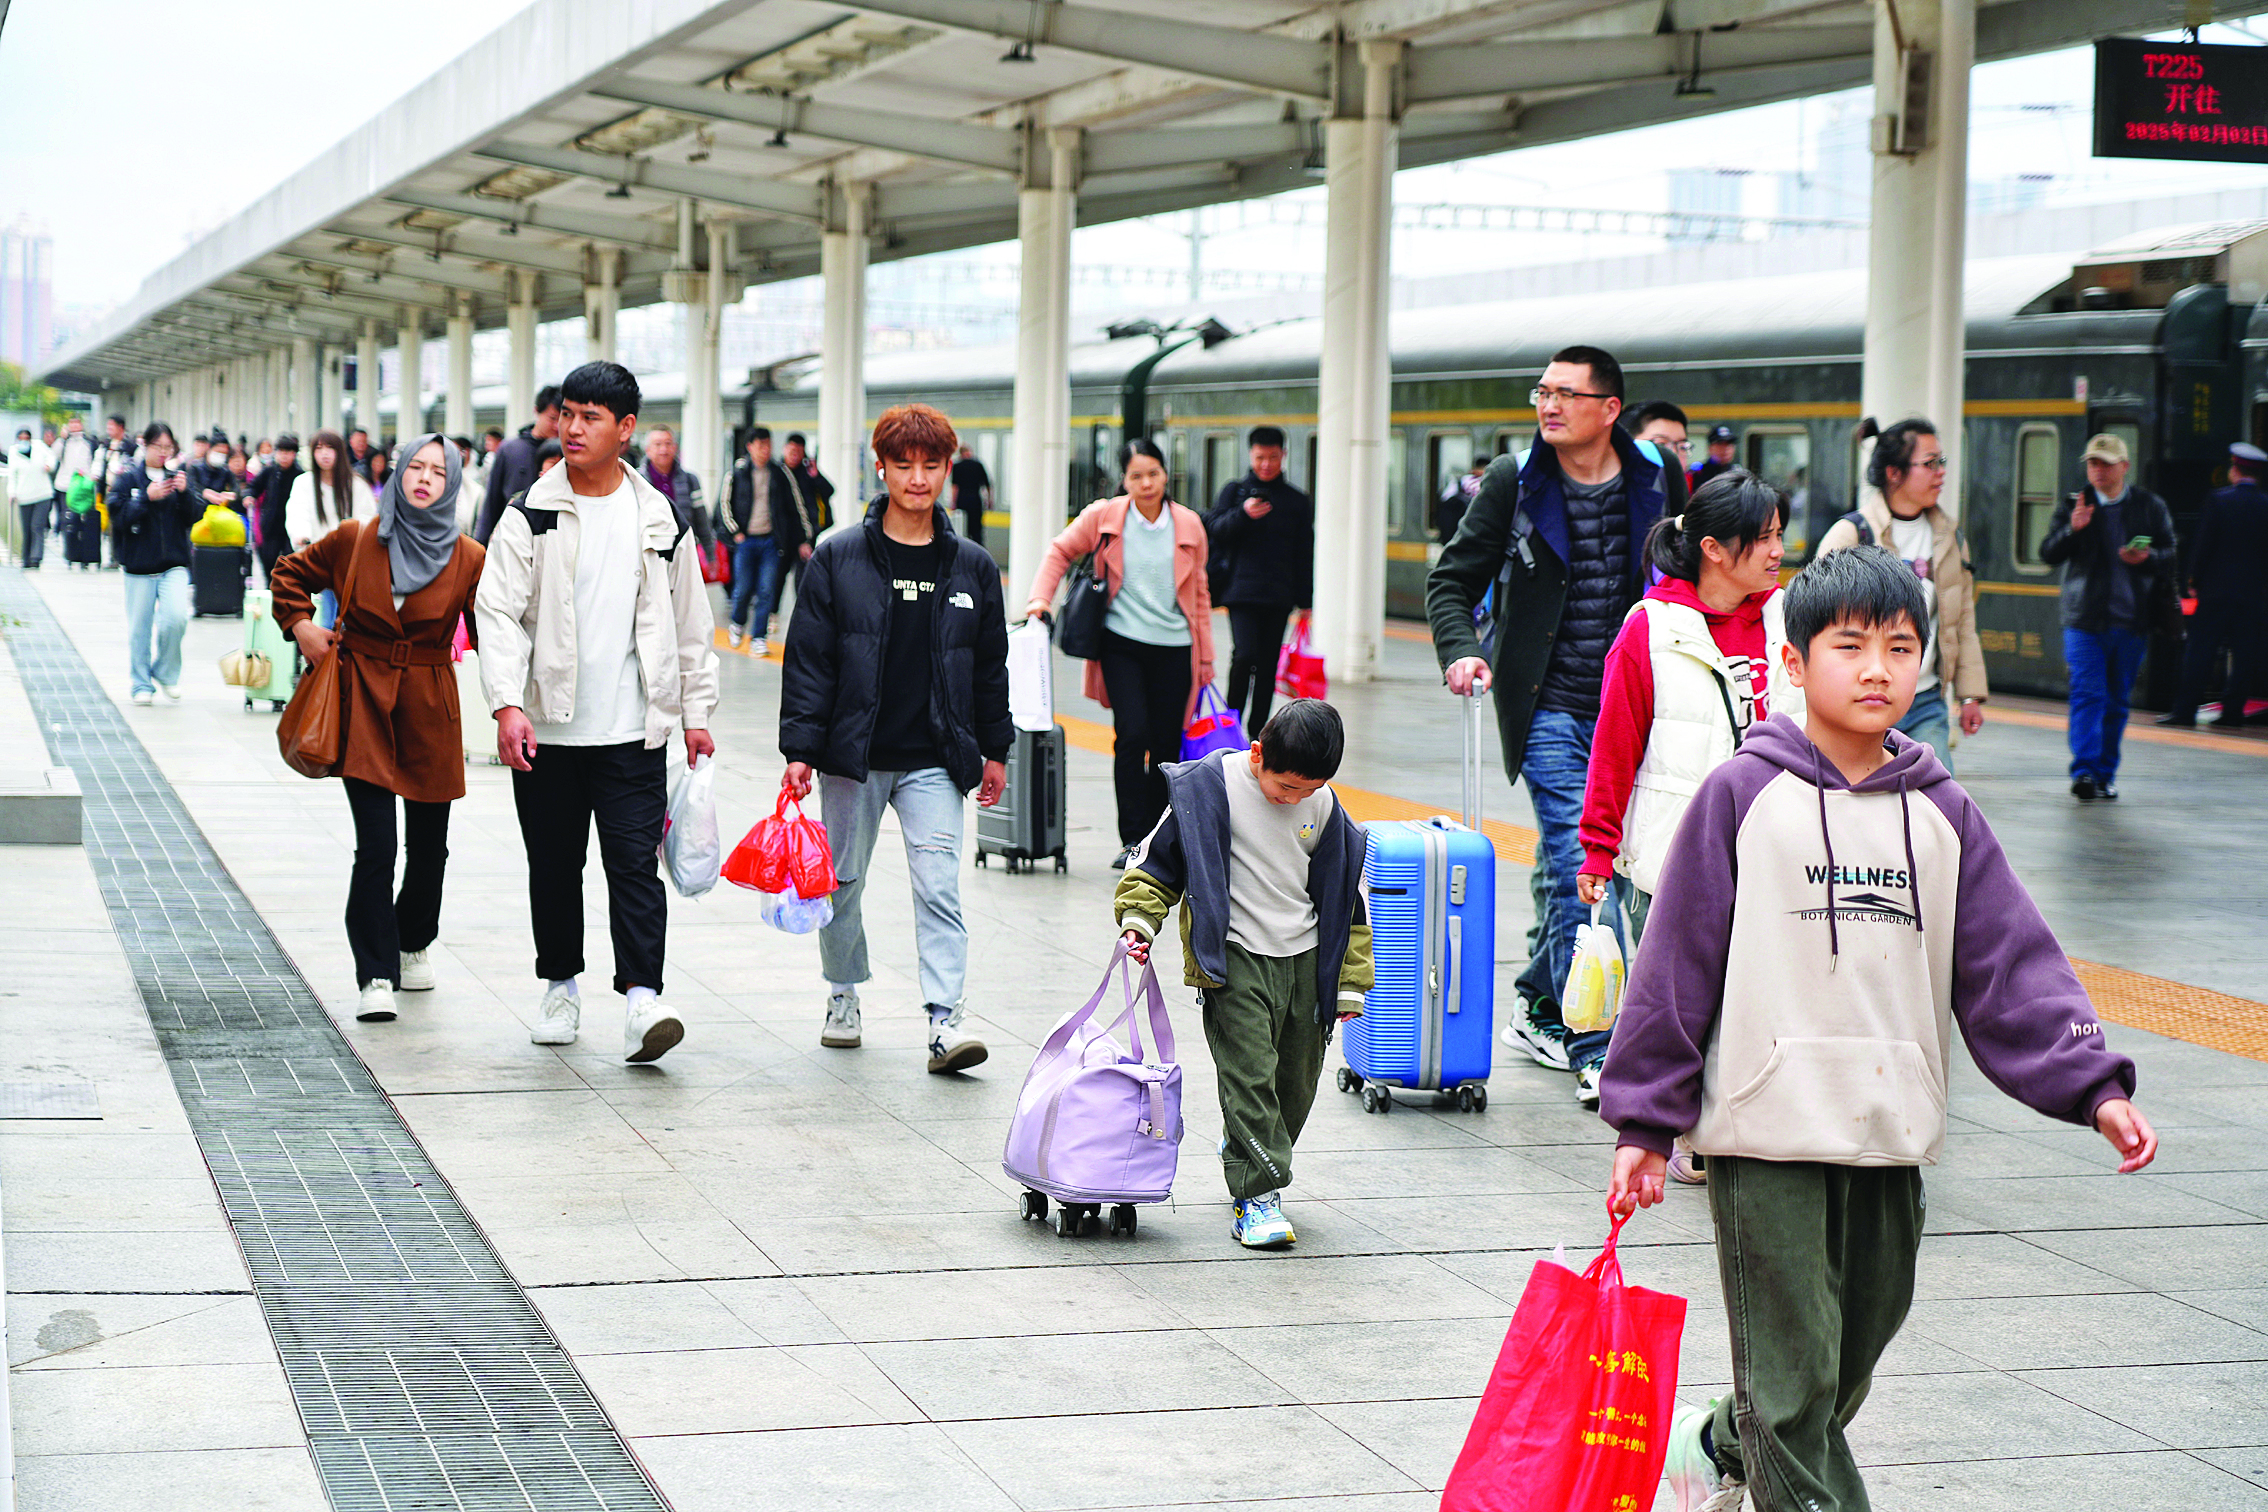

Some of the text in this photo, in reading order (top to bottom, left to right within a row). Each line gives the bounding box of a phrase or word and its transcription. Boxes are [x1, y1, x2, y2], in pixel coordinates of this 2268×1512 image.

[2143, 53, 2204, 79] T225
[2164, 83, 2222, 115] 开往
[1805, 865, 1914, 890] WELLNES
[1870, 913, 1912, 926] GARDEN
